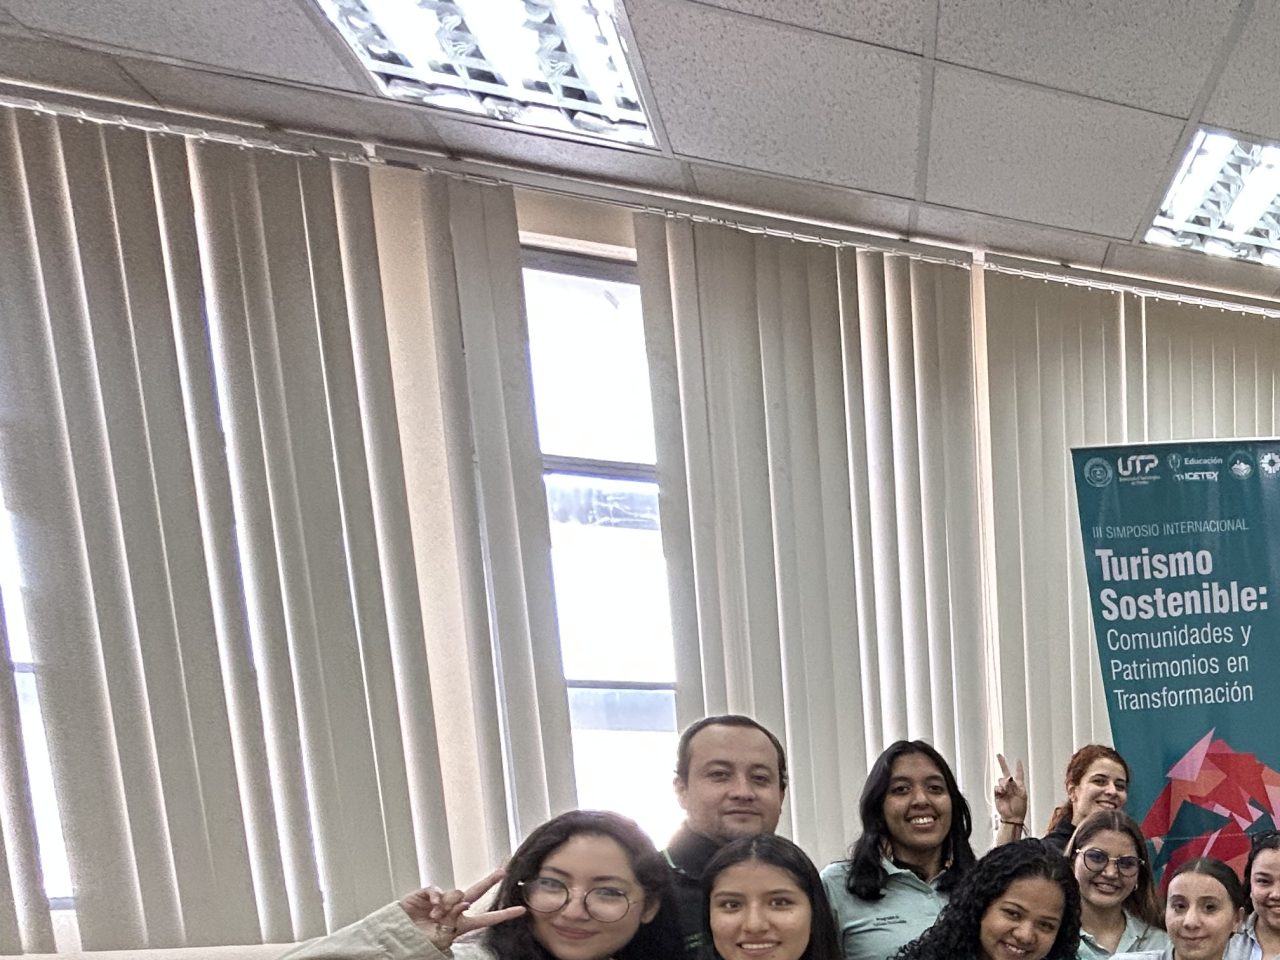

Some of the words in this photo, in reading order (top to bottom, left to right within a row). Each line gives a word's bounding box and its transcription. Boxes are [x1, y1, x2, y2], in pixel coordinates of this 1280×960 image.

[1117, 454, 1159, 476] UTP
[1184, 456, 1223, 466] Educación
[1184, 471, 1219, 482] ICETEX
[1092, 526, 1104, 539] III
[1106, 523, 1160, 539] SIMPOSIO
[1163, 518, 1249, 535] INTERNACIONAL
[1095, 547, 1213, 581] Turismo
[1100, 581, 1269, 621] Sostenible:
[1107, 622, 1234, 651] Comunidades
[1241, 624, 1251, 647] y
[1111, 654, 1219, 681] Patrimonios
[1227, 655, 1249, 673] en
[1114, 680, 1254, 710] Transformación
